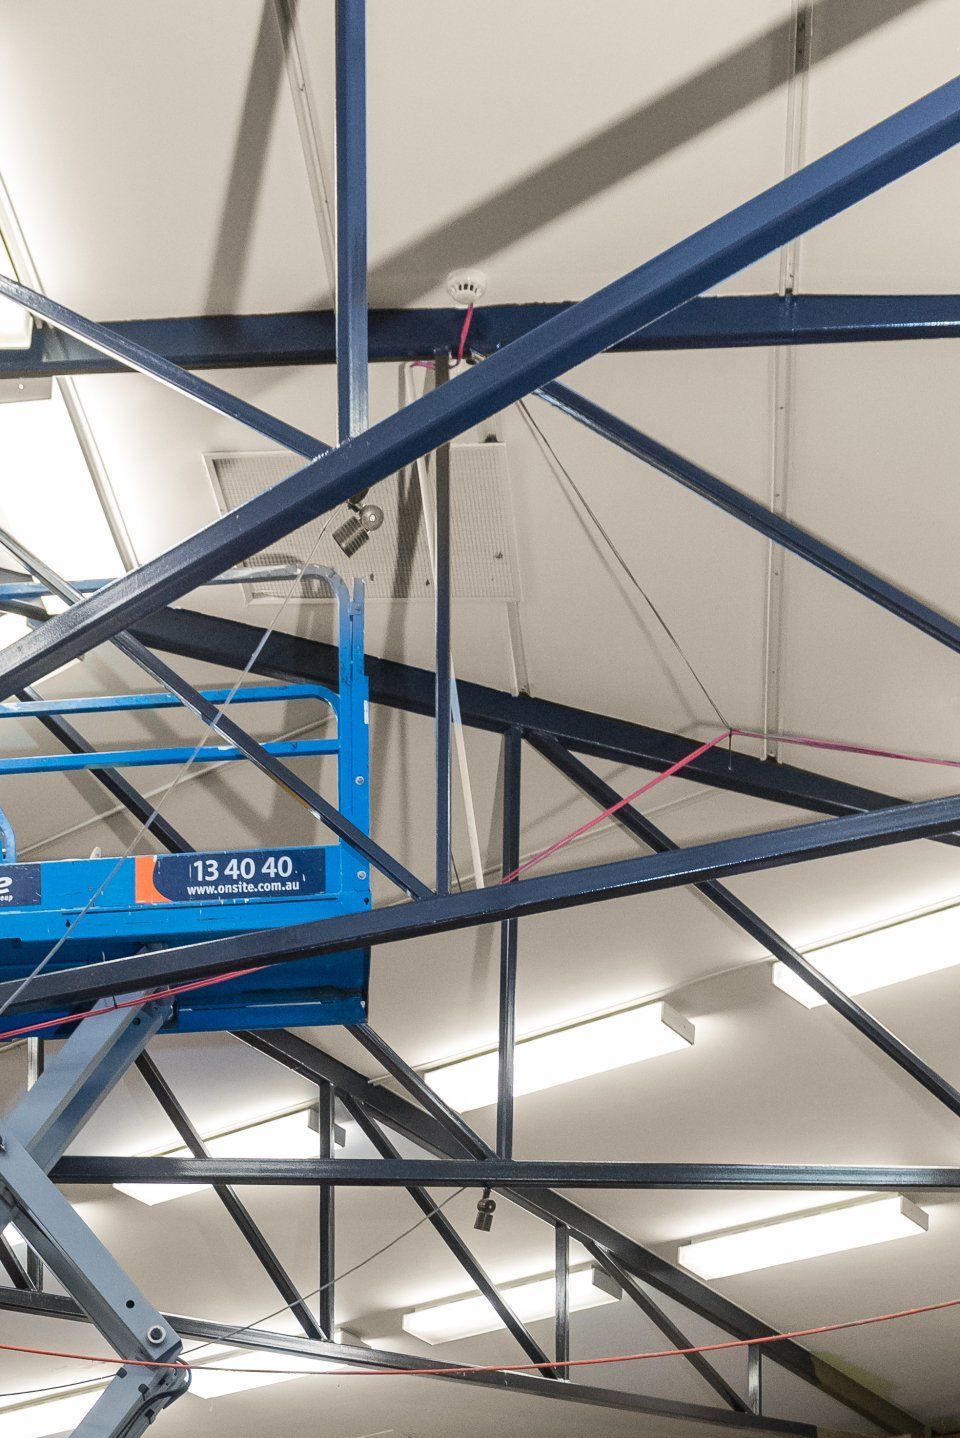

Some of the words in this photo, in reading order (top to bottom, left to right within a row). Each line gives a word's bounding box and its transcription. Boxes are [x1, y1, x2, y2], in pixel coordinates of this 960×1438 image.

[193, 860, 219, 882] 13
[224, 858, 256, 880] 40
[261, 856, 294, 878] 40
[187, 880, 300, 896] www.onsite.com.au
